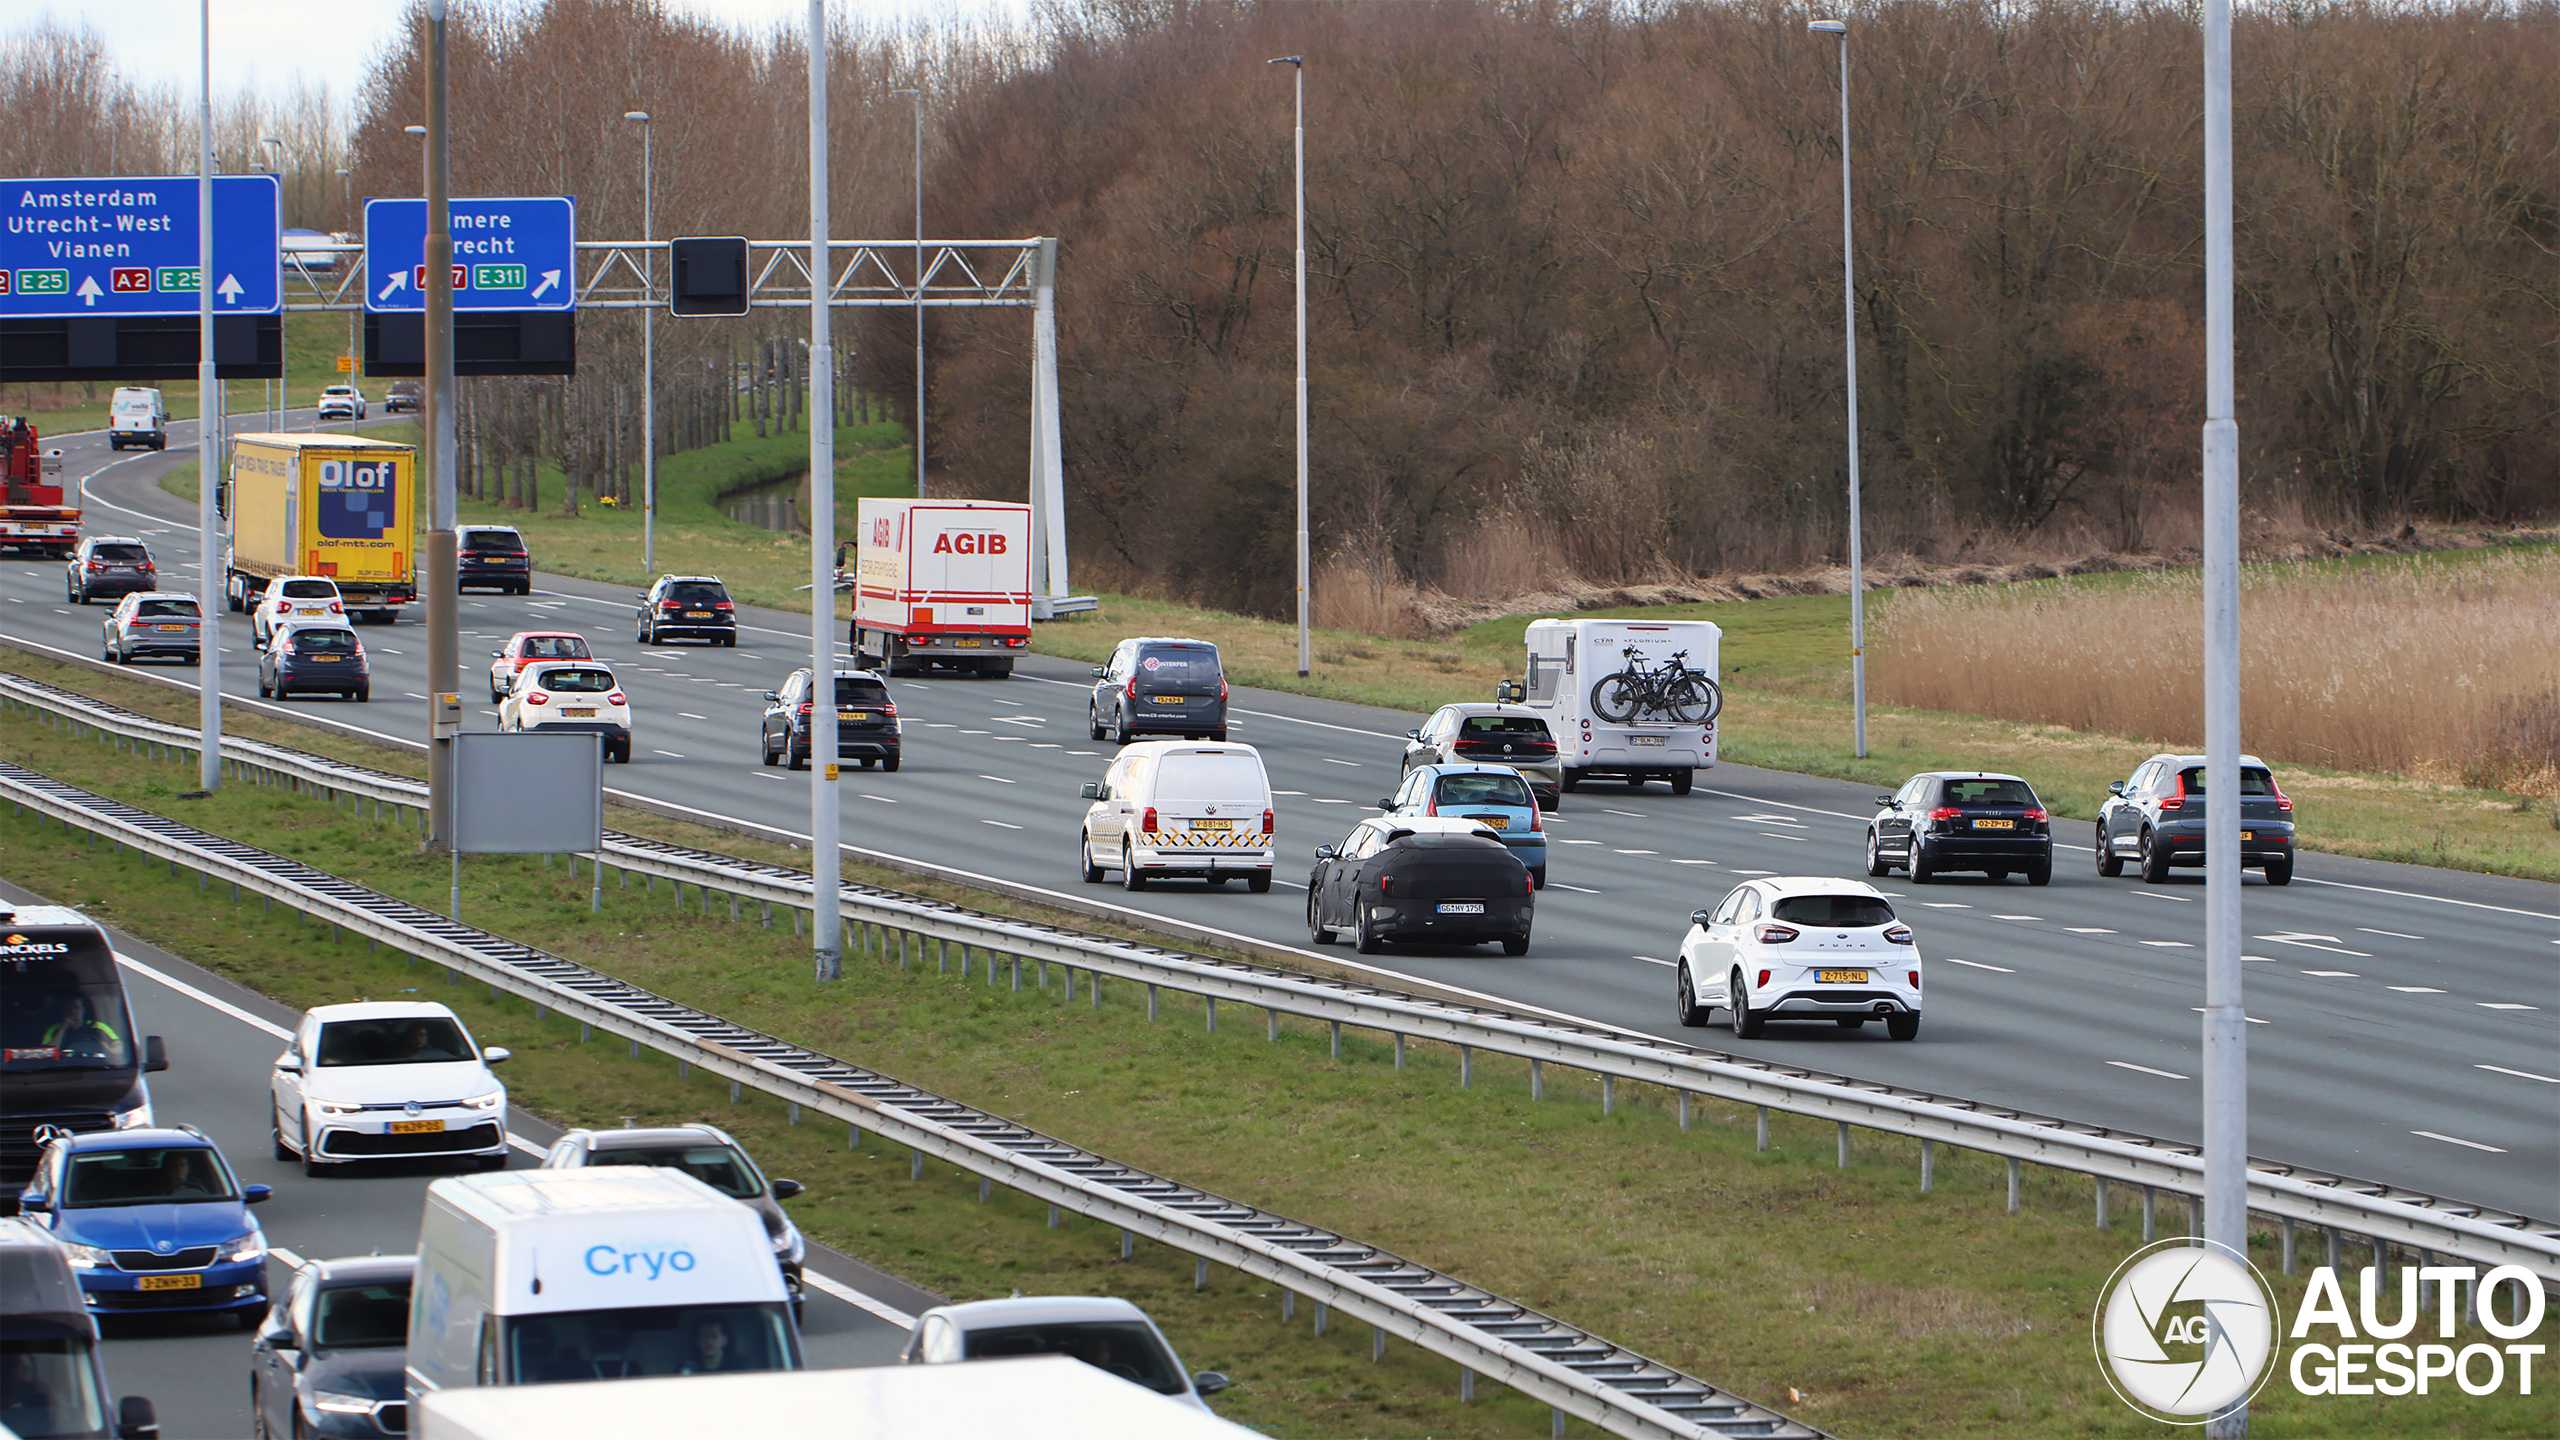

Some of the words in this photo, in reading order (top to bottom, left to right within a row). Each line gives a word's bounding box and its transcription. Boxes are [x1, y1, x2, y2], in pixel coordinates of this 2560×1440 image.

[20, 190, 157, 208] Amsterdam
[8, 214, 171, 234] Utrecht-West
[453, 214, 512, 229] mere
[48, 241, 131, 258] Vianen
[453, 236, 515, 255] recht
[319, 460, 390, 488] Olof
[873, 517, 890, 548] AGIB
[317, 540, 395, 548] olof-mtt.com
[933, 534, 1007, 555] AGIB
[1195, 820, 1228, 828] V-881-HS
[1825, 972, 1863, 980] Z-715-NL
[584, 1244, 696, 1281] Cryo
